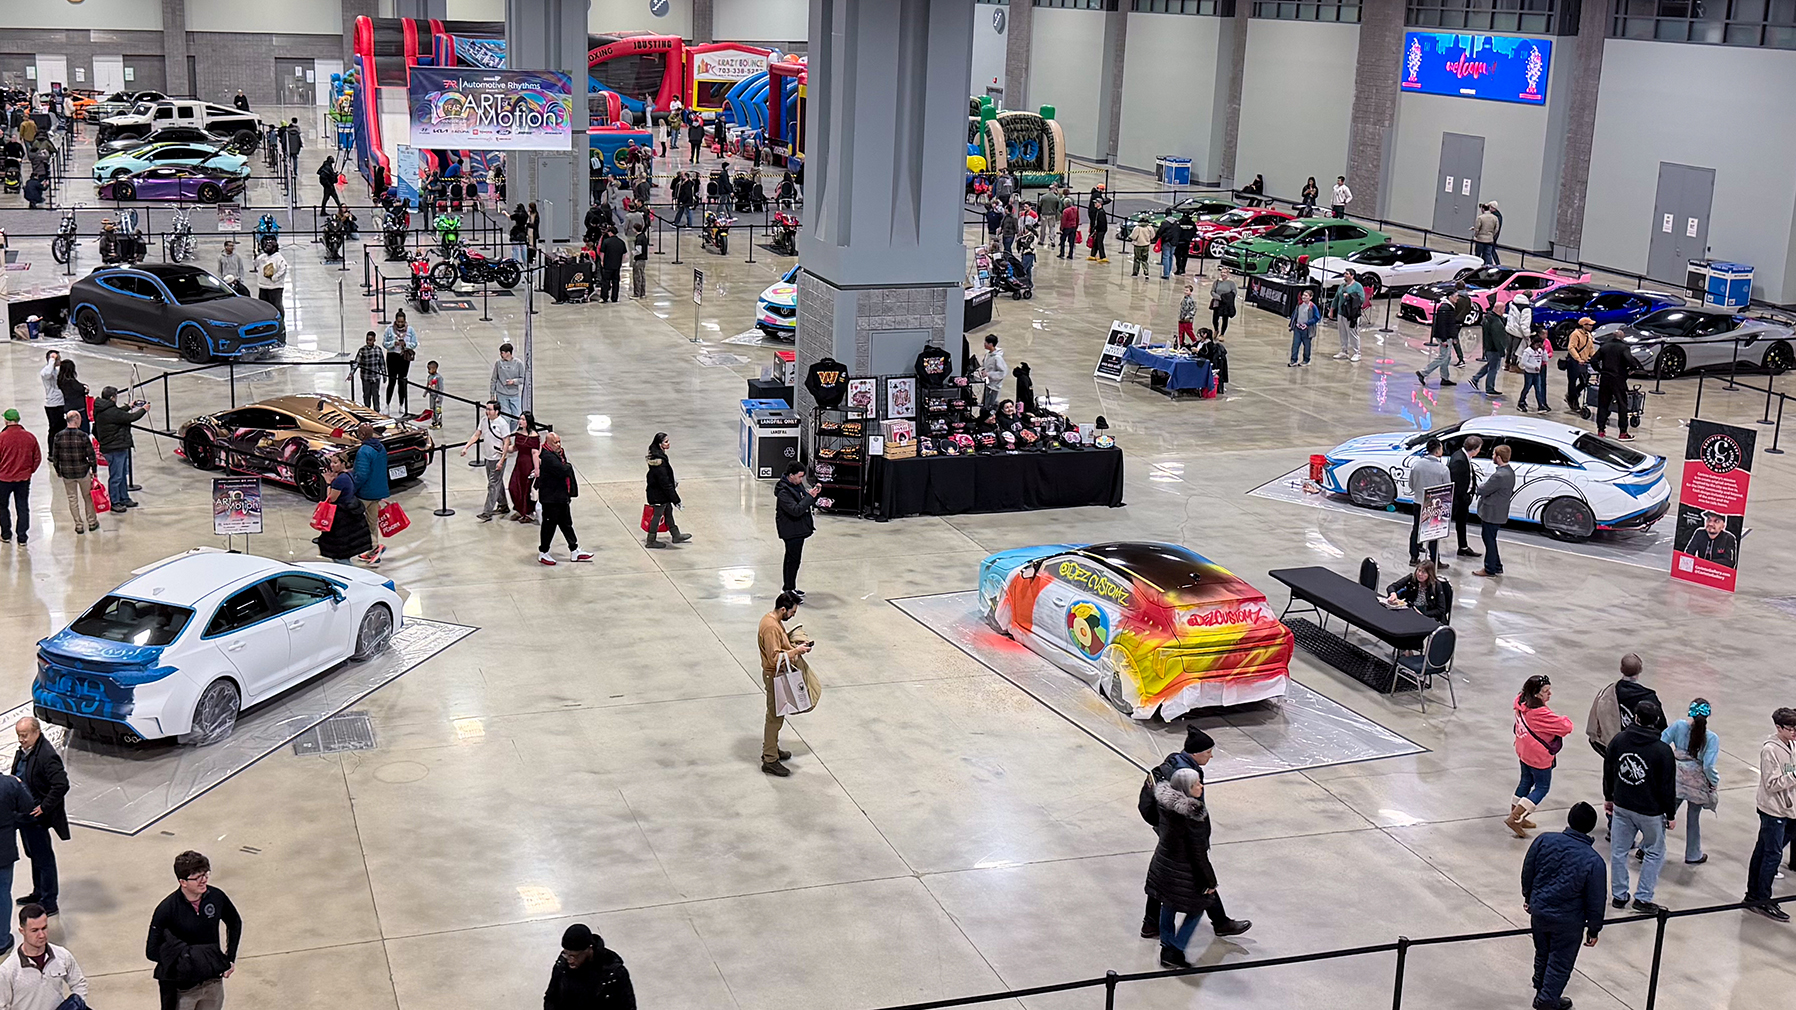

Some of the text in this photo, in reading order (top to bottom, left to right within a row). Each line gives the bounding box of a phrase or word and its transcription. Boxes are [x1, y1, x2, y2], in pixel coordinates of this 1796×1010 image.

[634, 40, 672, 49] JOUSTING
[588, 47, 613, 62] OXING
[718, 59, 764, 68] KRAZY BOUNCE
[1446, 52, 1497, 80] welcom!
[462, 80, 506, 89] Automotive
[508, 82, 540, 90] Rhythms
[462, 94, 505, 113] ART
[476, 106, 556, 127] Motion
[817, 371, 839, 384] W
